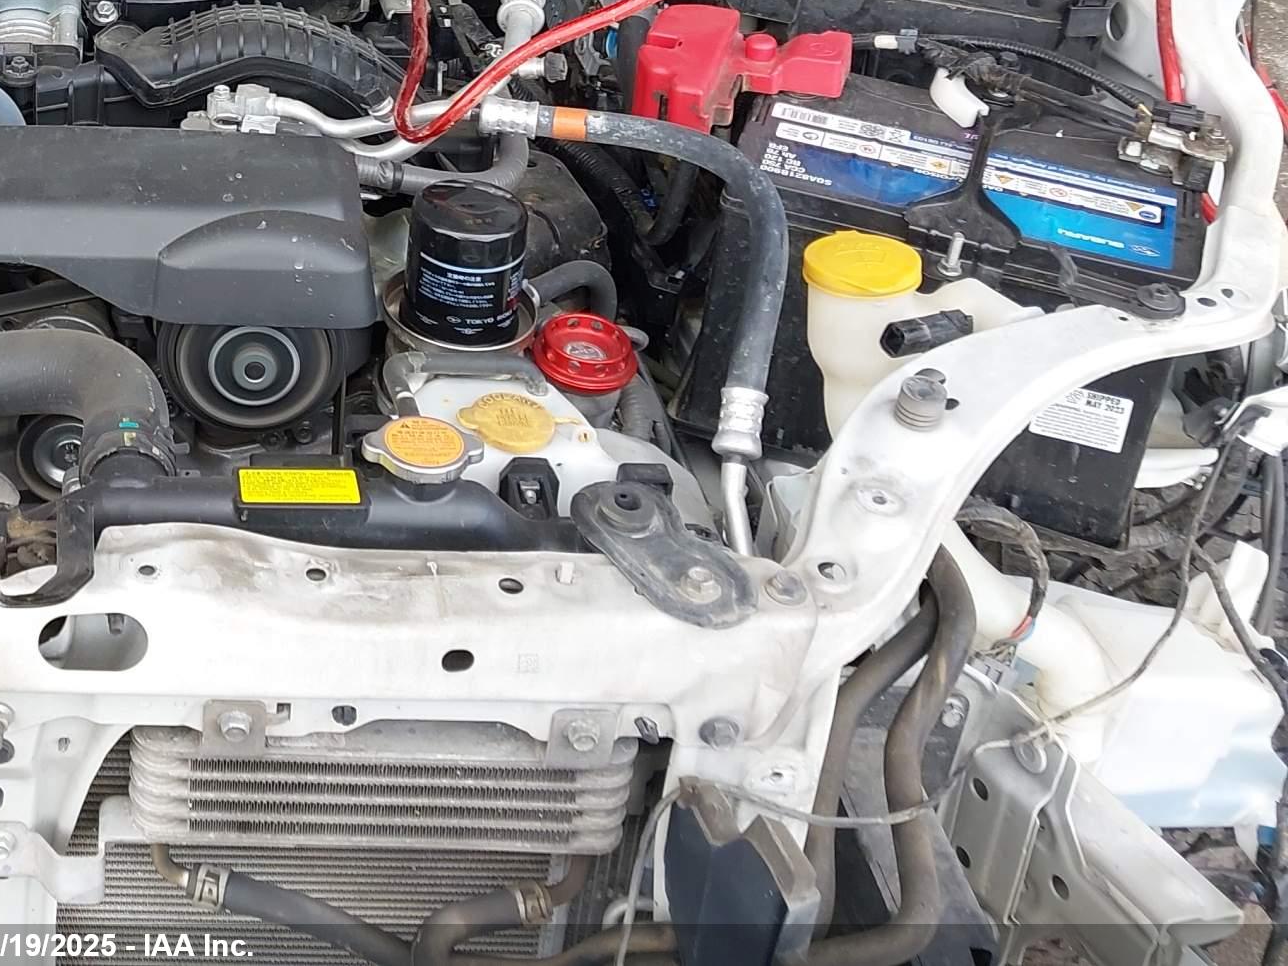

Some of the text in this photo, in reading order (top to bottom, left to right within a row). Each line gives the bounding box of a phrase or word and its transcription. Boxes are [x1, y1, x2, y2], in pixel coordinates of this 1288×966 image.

[783, 163, 806, 174] CCA
[1057, 227, 1125, 249] SUBARU
[465, 317, 495, 325] TOKYO
[478, 393, 545, 410] COOLANT
[1085, 400, 1103, 409] MAY
[1087, 392, 1121, 406] SHIPPED
